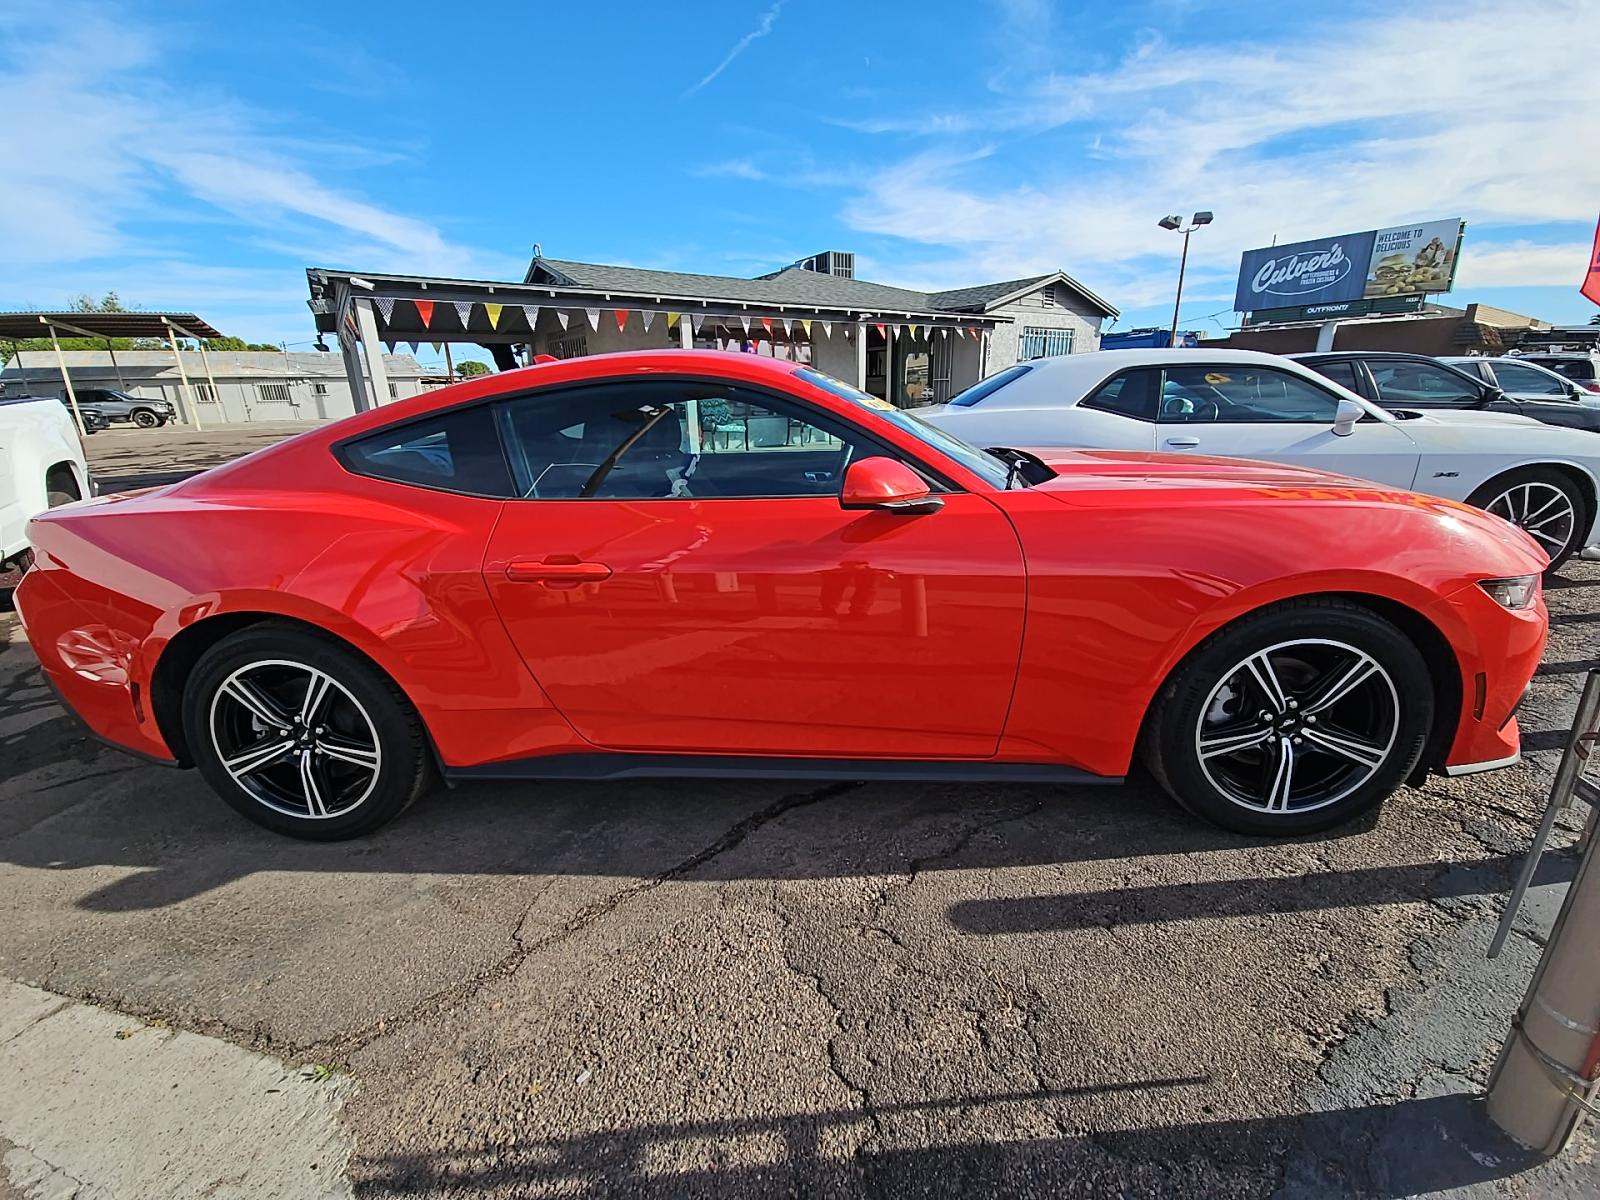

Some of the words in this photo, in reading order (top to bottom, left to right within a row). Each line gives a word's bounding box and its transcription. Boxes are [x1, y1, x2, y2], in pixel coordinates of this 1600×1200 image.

[1379, 231, 1411, 243] WELCOME
[1413, 229, 1423, 238] TO
[1376, 240, 1411, 252] DELICIOUS
[1252, 243, 1345, 293] Culver's
